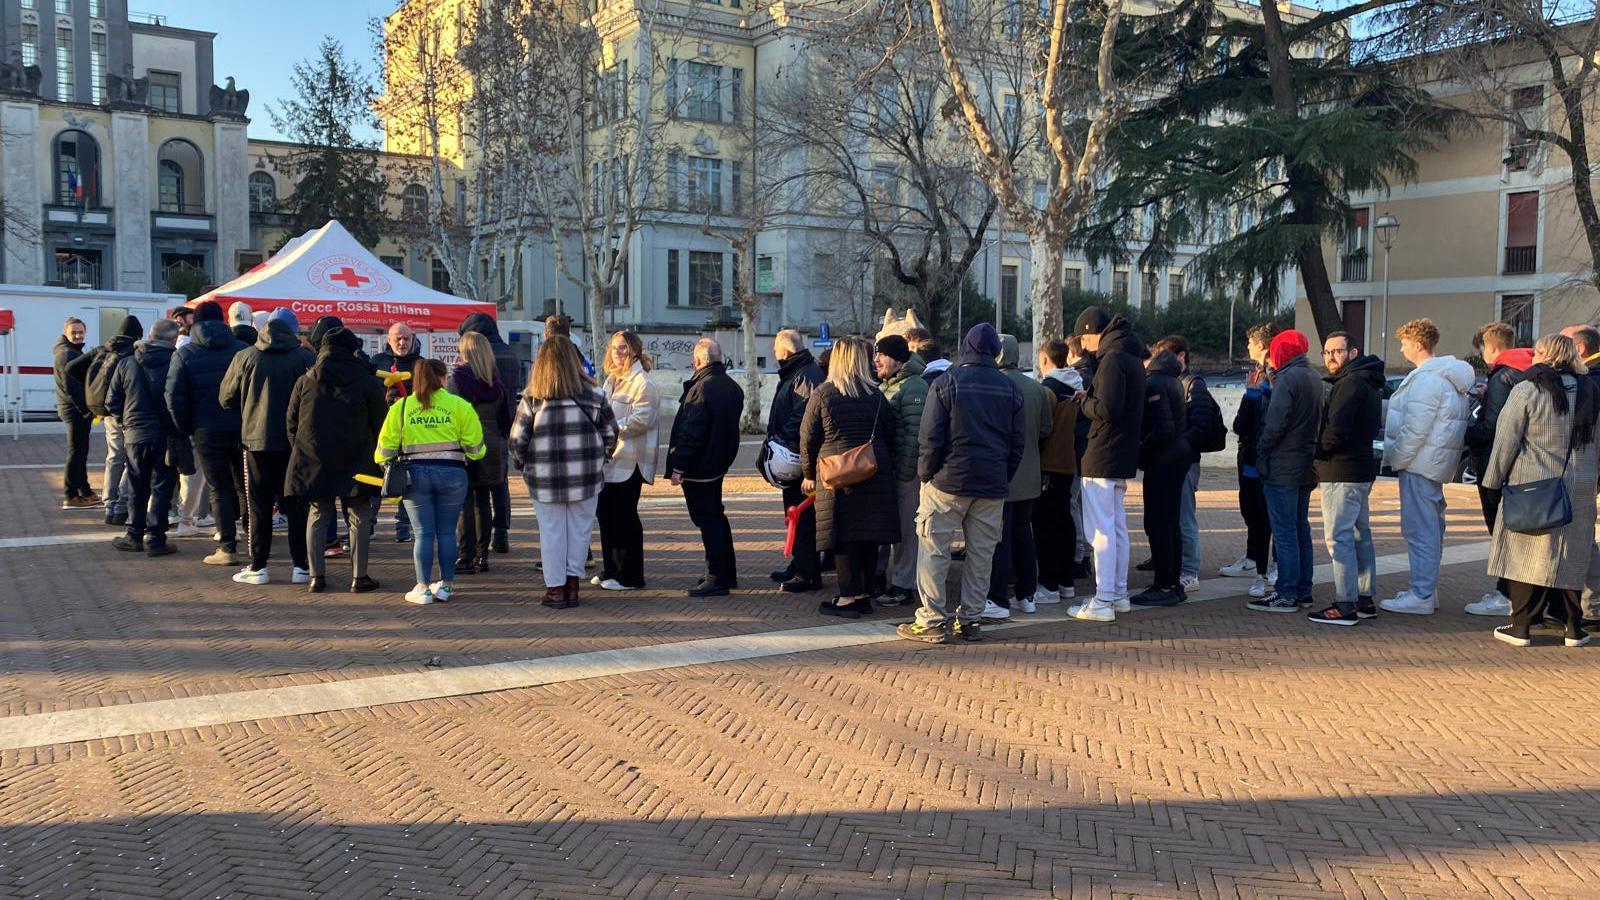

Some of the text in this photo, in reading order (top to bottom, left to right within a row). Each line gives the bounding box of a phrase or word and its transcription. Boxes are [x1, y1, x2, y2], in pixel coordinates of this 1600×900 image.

[291, 301, 431, 316] Croce Rossa Italiana
[410, 416, 451, 425] ARVALIA
